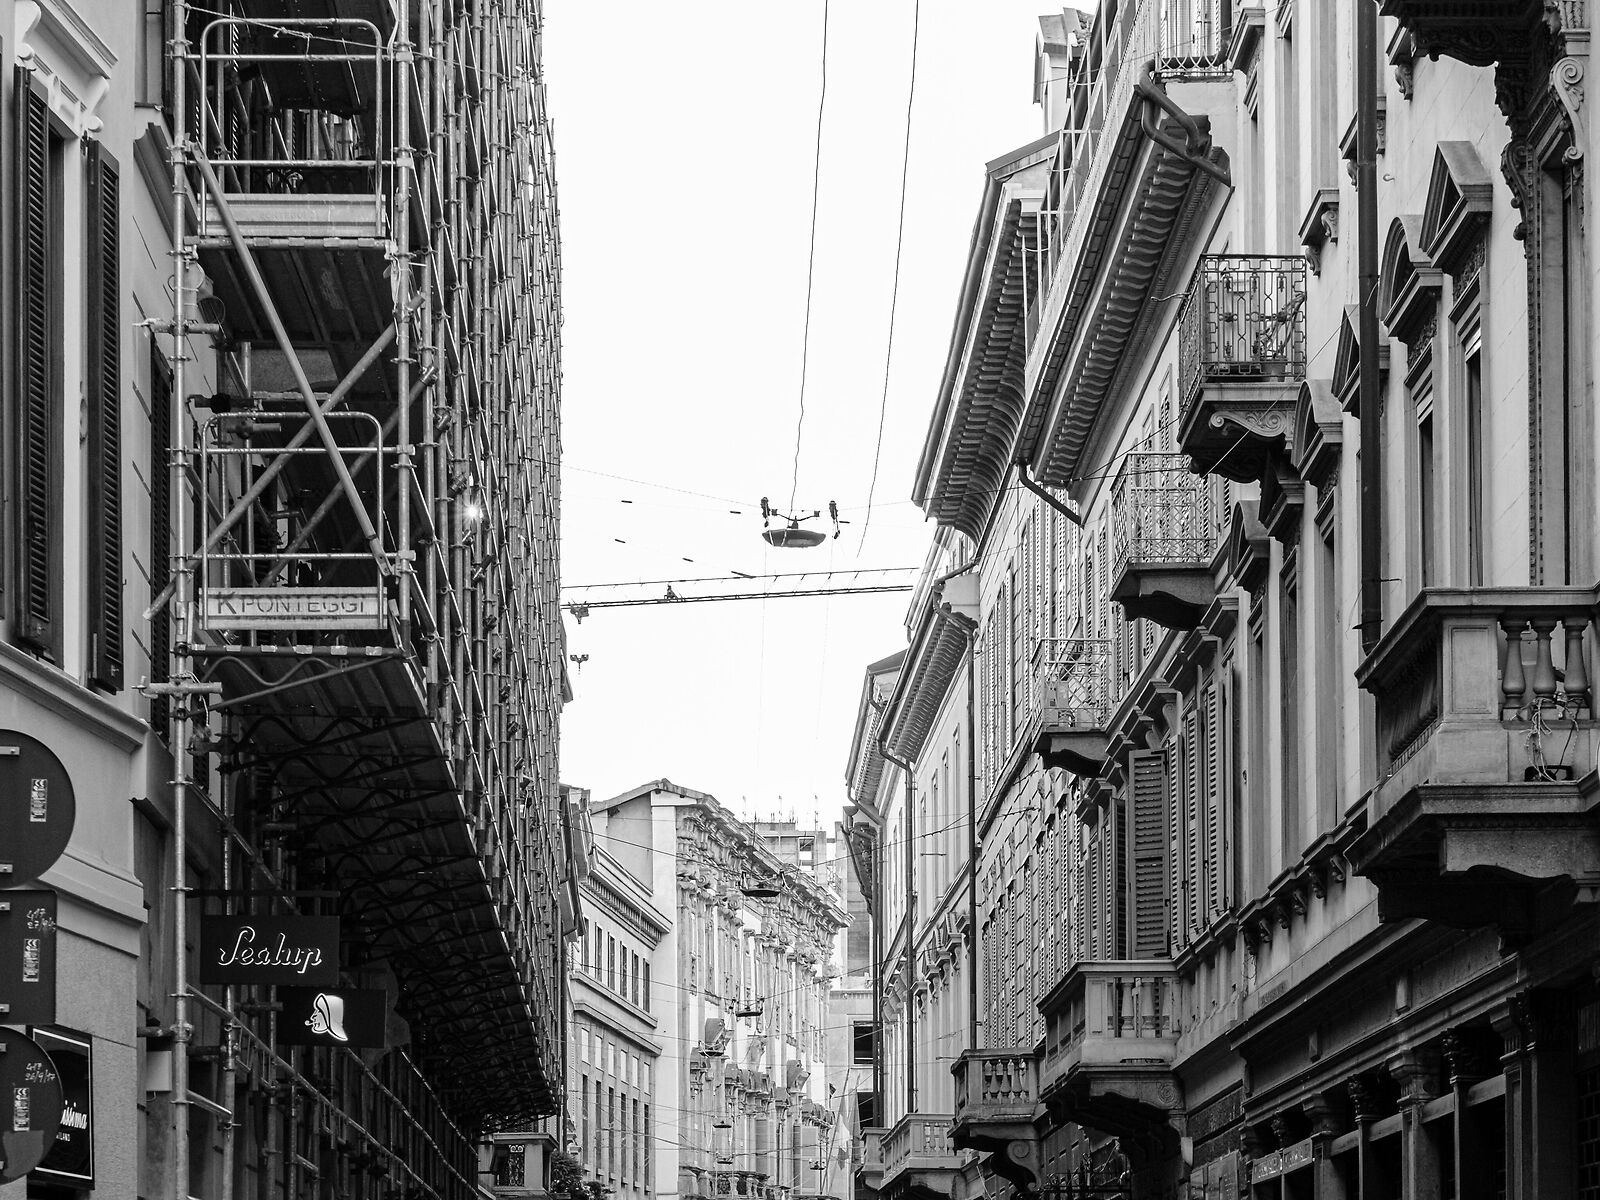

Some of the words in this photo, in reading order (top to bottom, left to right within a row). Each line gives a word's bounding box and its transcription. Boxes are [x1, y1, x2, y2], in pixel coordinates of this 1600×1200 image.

[217, 591, 237, 614] K
[241, 594, 364, 613] PONTEGGI
[218, 926, 322, 974] Sealup
